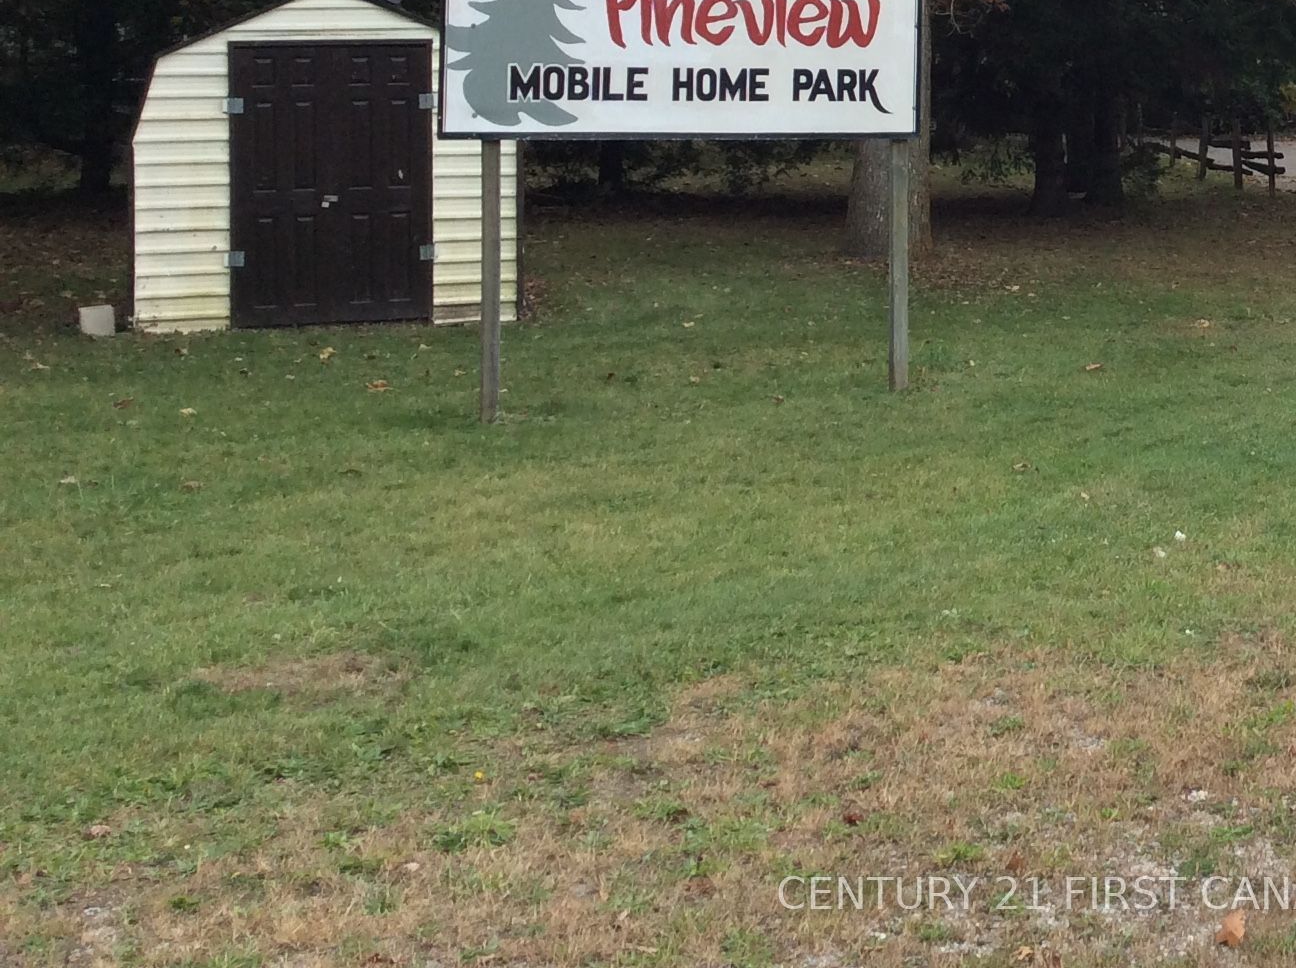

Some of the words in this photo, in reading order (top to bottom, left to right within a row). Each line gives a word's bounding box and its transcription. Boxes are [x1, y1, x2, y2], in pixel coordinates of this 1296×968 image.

[509, 65, 649, 102] MOBILE
[672, 67, 770, 102] HOME
[792, 67, 893, 115] PARK
